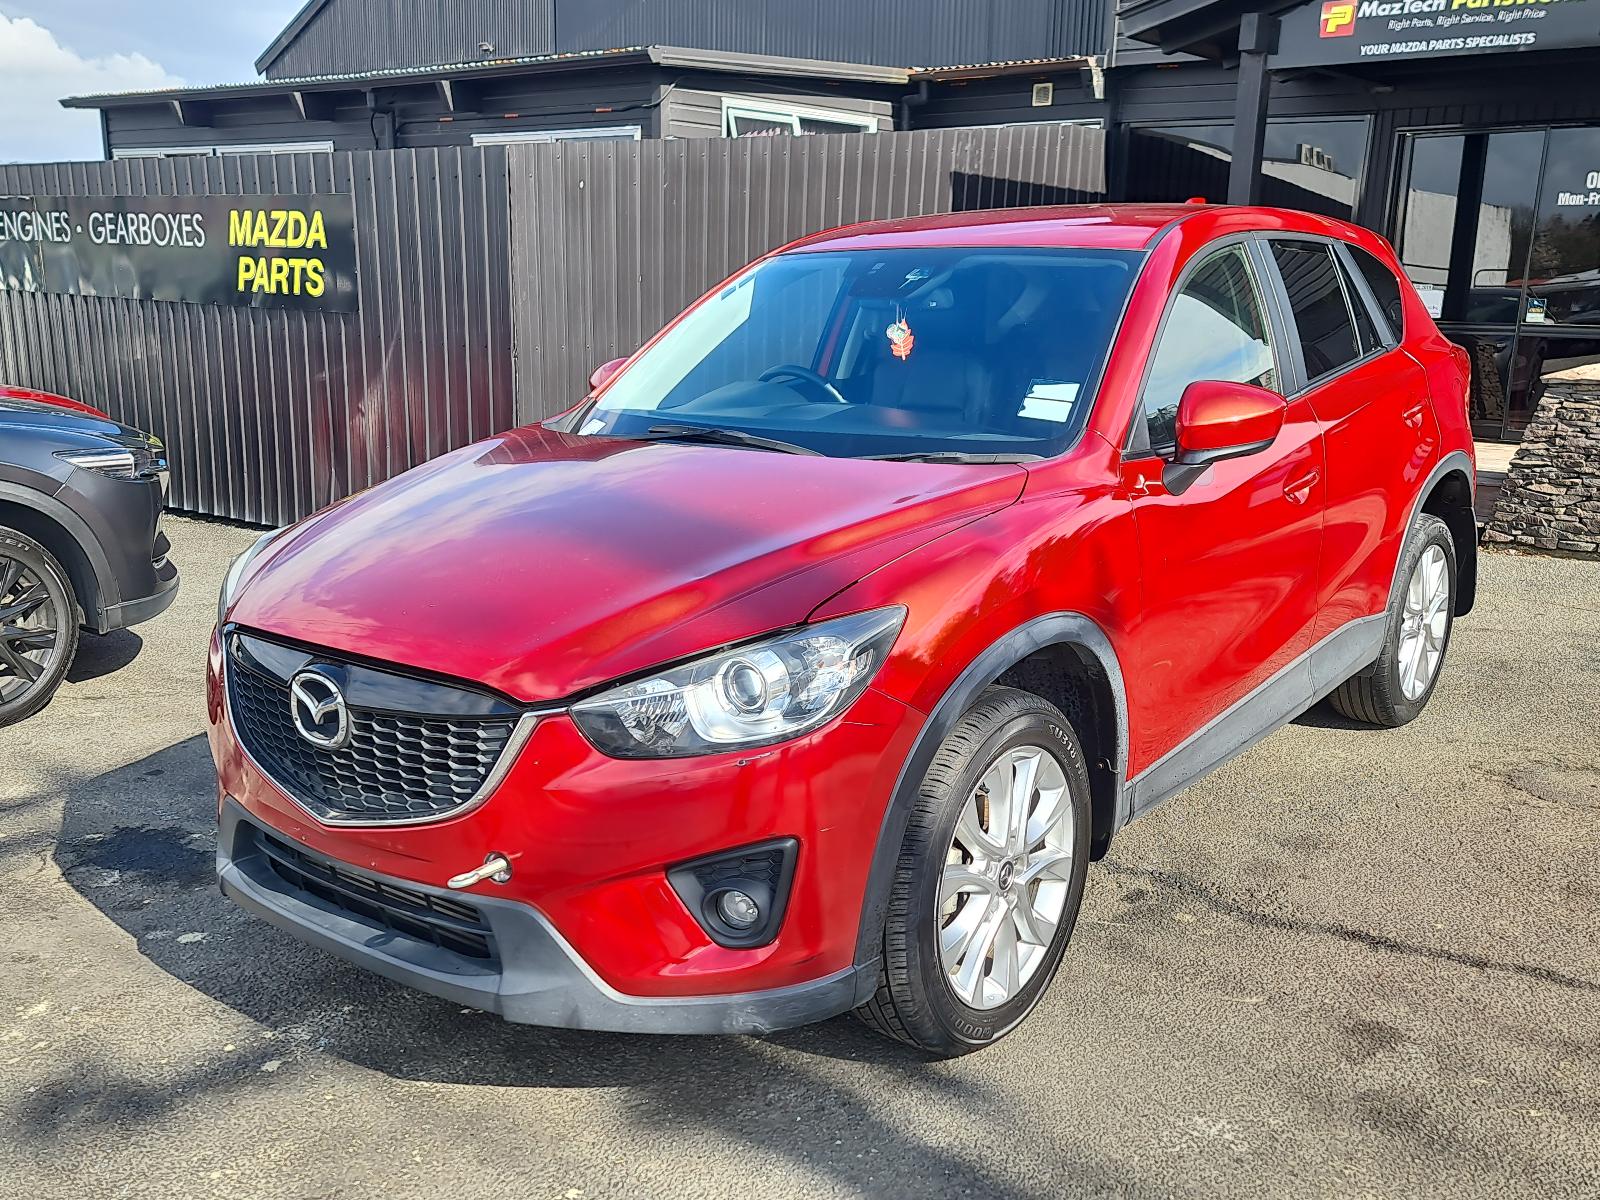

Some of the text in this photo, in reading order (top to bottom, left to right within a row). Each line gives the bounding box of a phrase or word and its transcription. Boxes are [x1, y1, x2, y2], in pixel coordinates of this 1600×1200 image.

[1357, 0, 1447, 17] MazTech
[1387, 19, 1410, 31] Right
[1436, 15, 1461, 28] Right
[1497, 9, 1522, 23] Right
[1522, 8, 1547, 19] Price
[1360, 32, 1537, 56] YOUR MAZDA PARTS SPECIALISTS
[88, 211, 206, 248] GEARBOXES
[228, 209, 328, 249] MAZDA
[237, 255, 326, 298] PARTS
